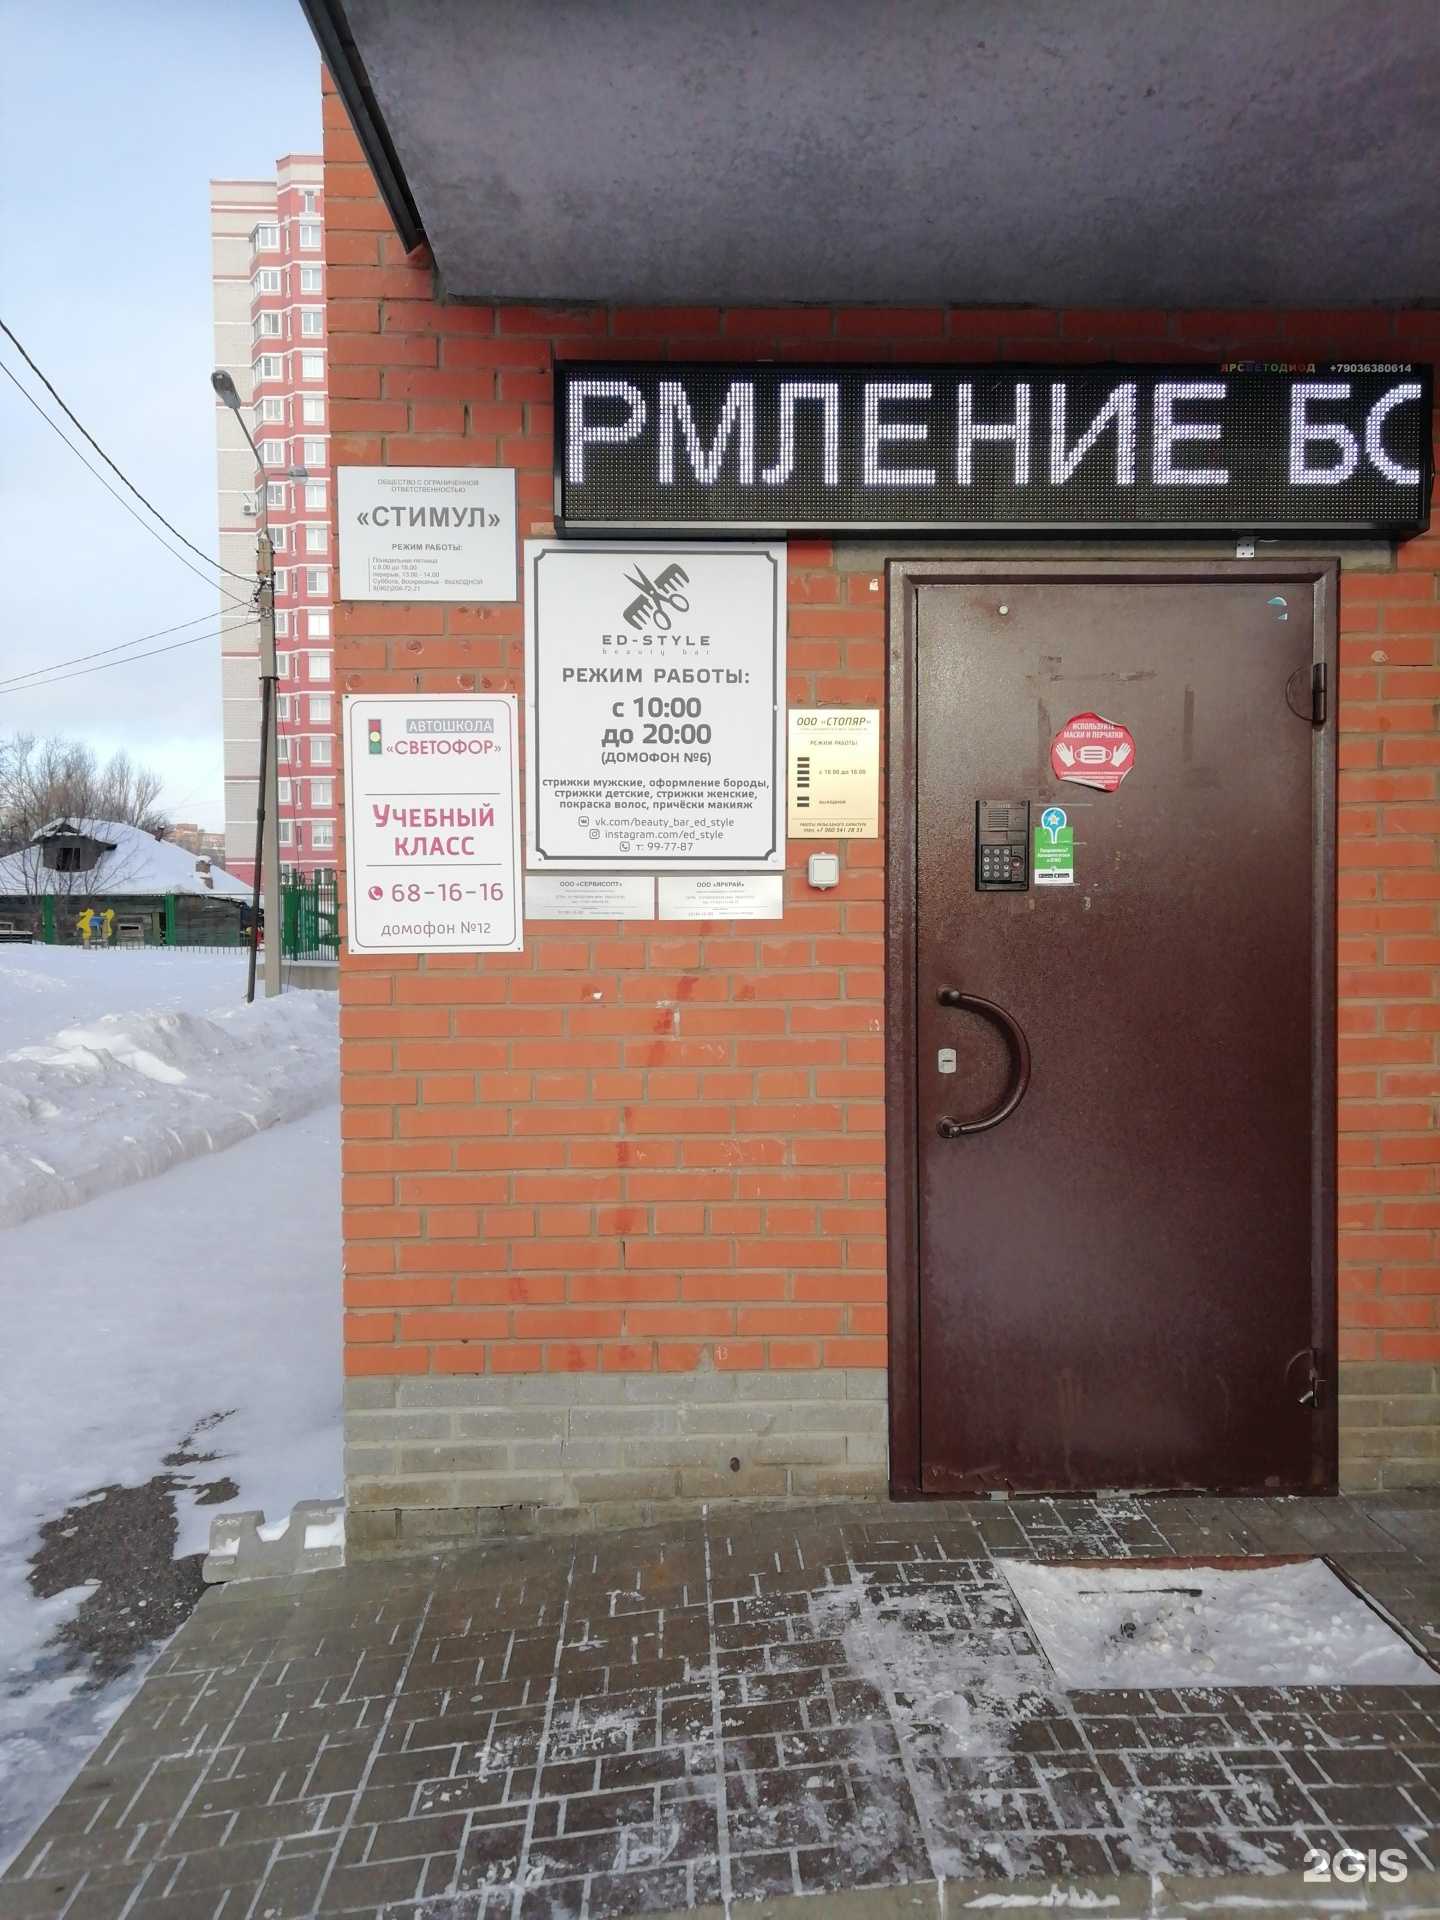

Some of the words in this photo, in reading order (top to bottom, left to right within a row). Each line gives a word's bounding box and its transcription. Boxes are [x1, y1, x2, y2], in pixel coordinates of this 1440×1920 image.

[1330, 364, 1412, 373] +79036380614
[568, 380, 1229, 486] РМЛЕНИЕ
[357, 506, 500, 527] «СТИМУЛ»
[602, 635, 710, 645] ED-STYLE
[562, 668, 643, 683] РЕЖИМ
[654, 668, 750, 684] РАБОТЫ:
[612, 701, 624, 718] с
[633, 697, 701, 718] 10:00
[408, 720, 492, 732] АВТОШКОЛА
[797, 717, 817, 726] ООО
[601, 727, 634, 748] до
[642, 724, 711, 744] 20:00
[387, 740, 501, 755] «СВЕТОФОР»
[601, 752, 680, 765] (ДОМОФОН
[684, 752, 711, 765] №6)
[543, 779, 590, 788] стрижки
[593, 779, 646, 788] мужские,
[649, 778, 720, 788] оформление
[724, 778, 769, 789] бороды,
[555, 790, 602, 799] стрижки
[605, 790, 653, 799] детские,
[656, 790, 704, 799] стрижки
[707, 790, 758, 800] женские,
[560, 801, 611, 810] покраска
[614, 801, 650, 810] волос,
[653, 800, 705, 810] причёски
[372, 803, 494, 828] УЧЕБНЫЙ
[595, 818, 734, 829] vk.com/beauty_bar_ed_style
[605, 830, 724, 840] instagram.com/ed_style
[395, 836, 474, 856] КЛАСС
[648, 842, 693, 851] 99-77-87
[392, 883, 504, 902] 68-16-16
[381, 921, 455, 938] домофон
[461, 922, 491, 934] №12
